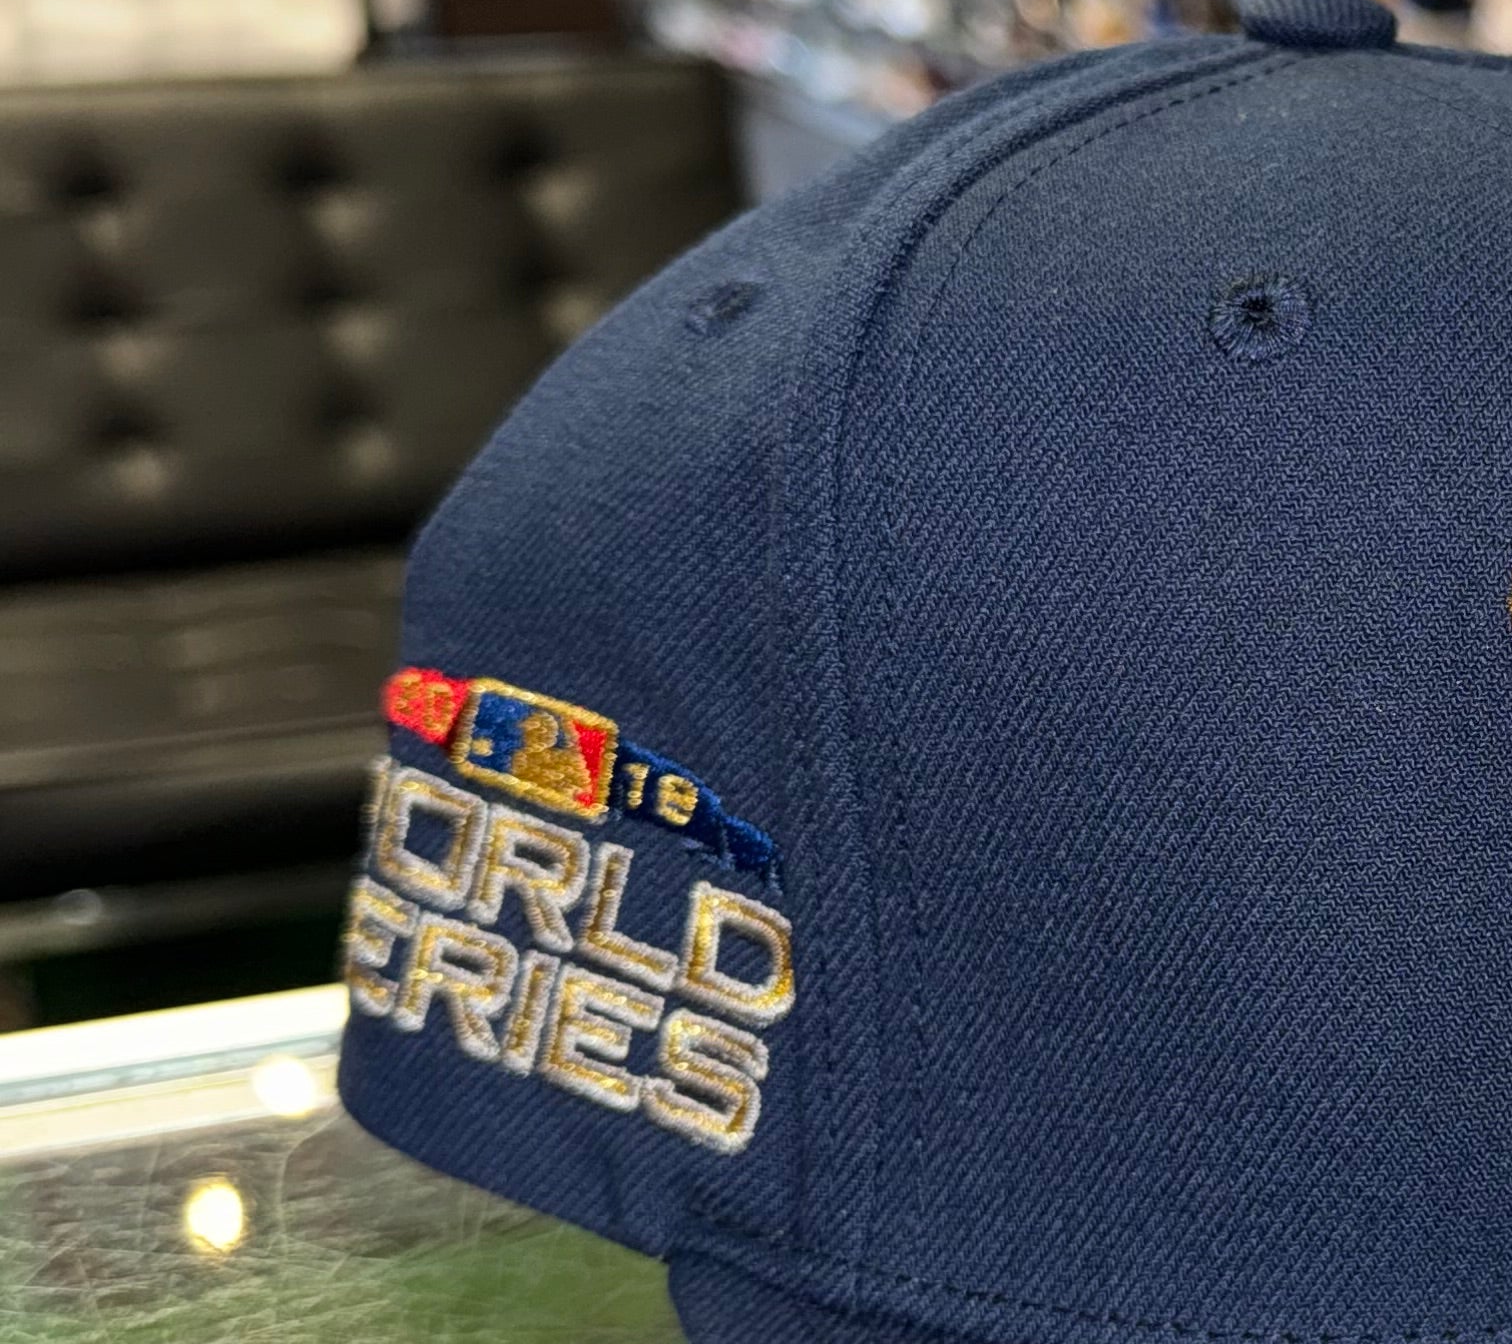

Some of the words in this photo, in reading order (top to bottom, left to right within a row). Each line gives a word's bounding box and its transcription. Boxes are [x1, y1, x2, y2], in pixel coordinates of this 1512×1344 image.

[362, 754, 797, 1030] ORLD
[622, 761, 700, 826] 18
[341, 873, 770, 1154] ERIES
